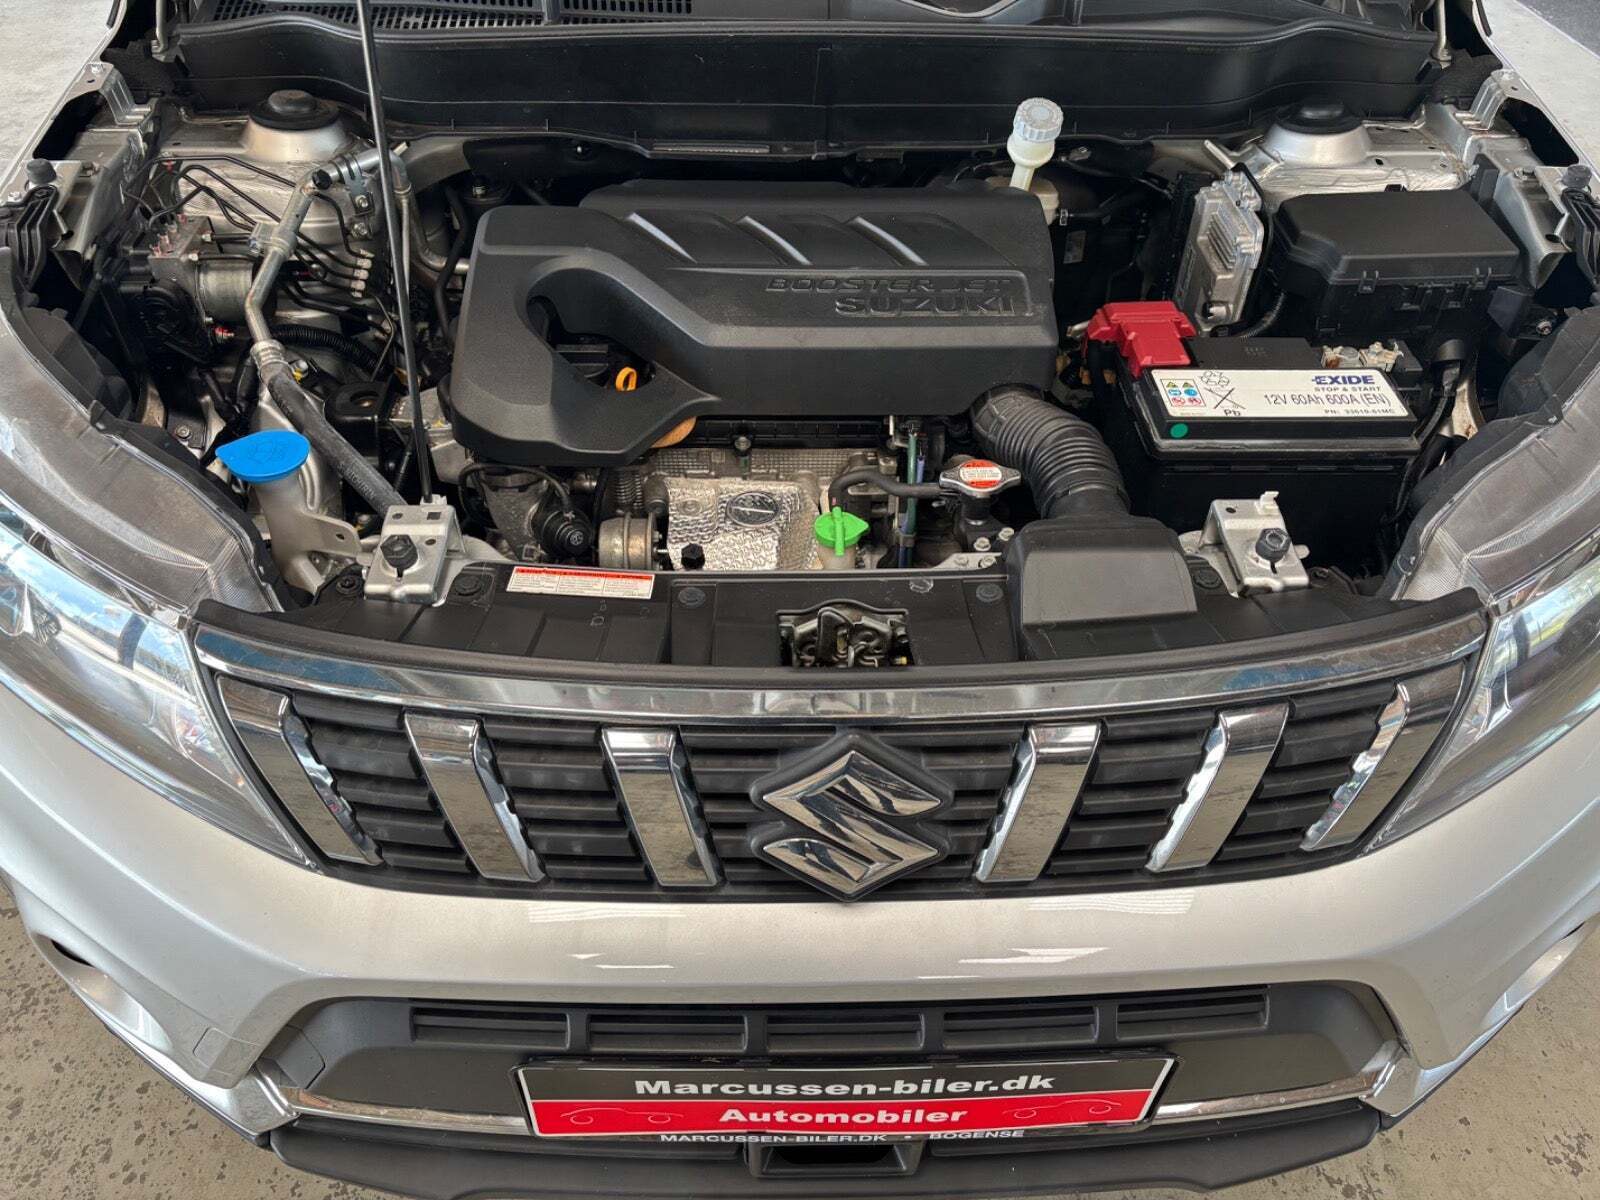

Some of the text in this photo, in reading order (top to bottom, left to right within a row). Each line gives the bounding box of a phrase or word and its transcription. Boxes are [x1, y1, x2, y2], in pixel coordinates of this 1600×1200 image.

[835, 296, 1016, 317] SUZUKI
[1312, 374, 1376, 386] EXIDE
[1264, 392, 1392, 408] 12V 60Ah 600A (EN)
[634, 1074, 1056, 1097] Marcussen-biler.dk
[718, 1107, 969, 1125] Automobiler
[659, 1128, 1026, 1144] MARCUSSEN-BILER.DK BOGENSE
